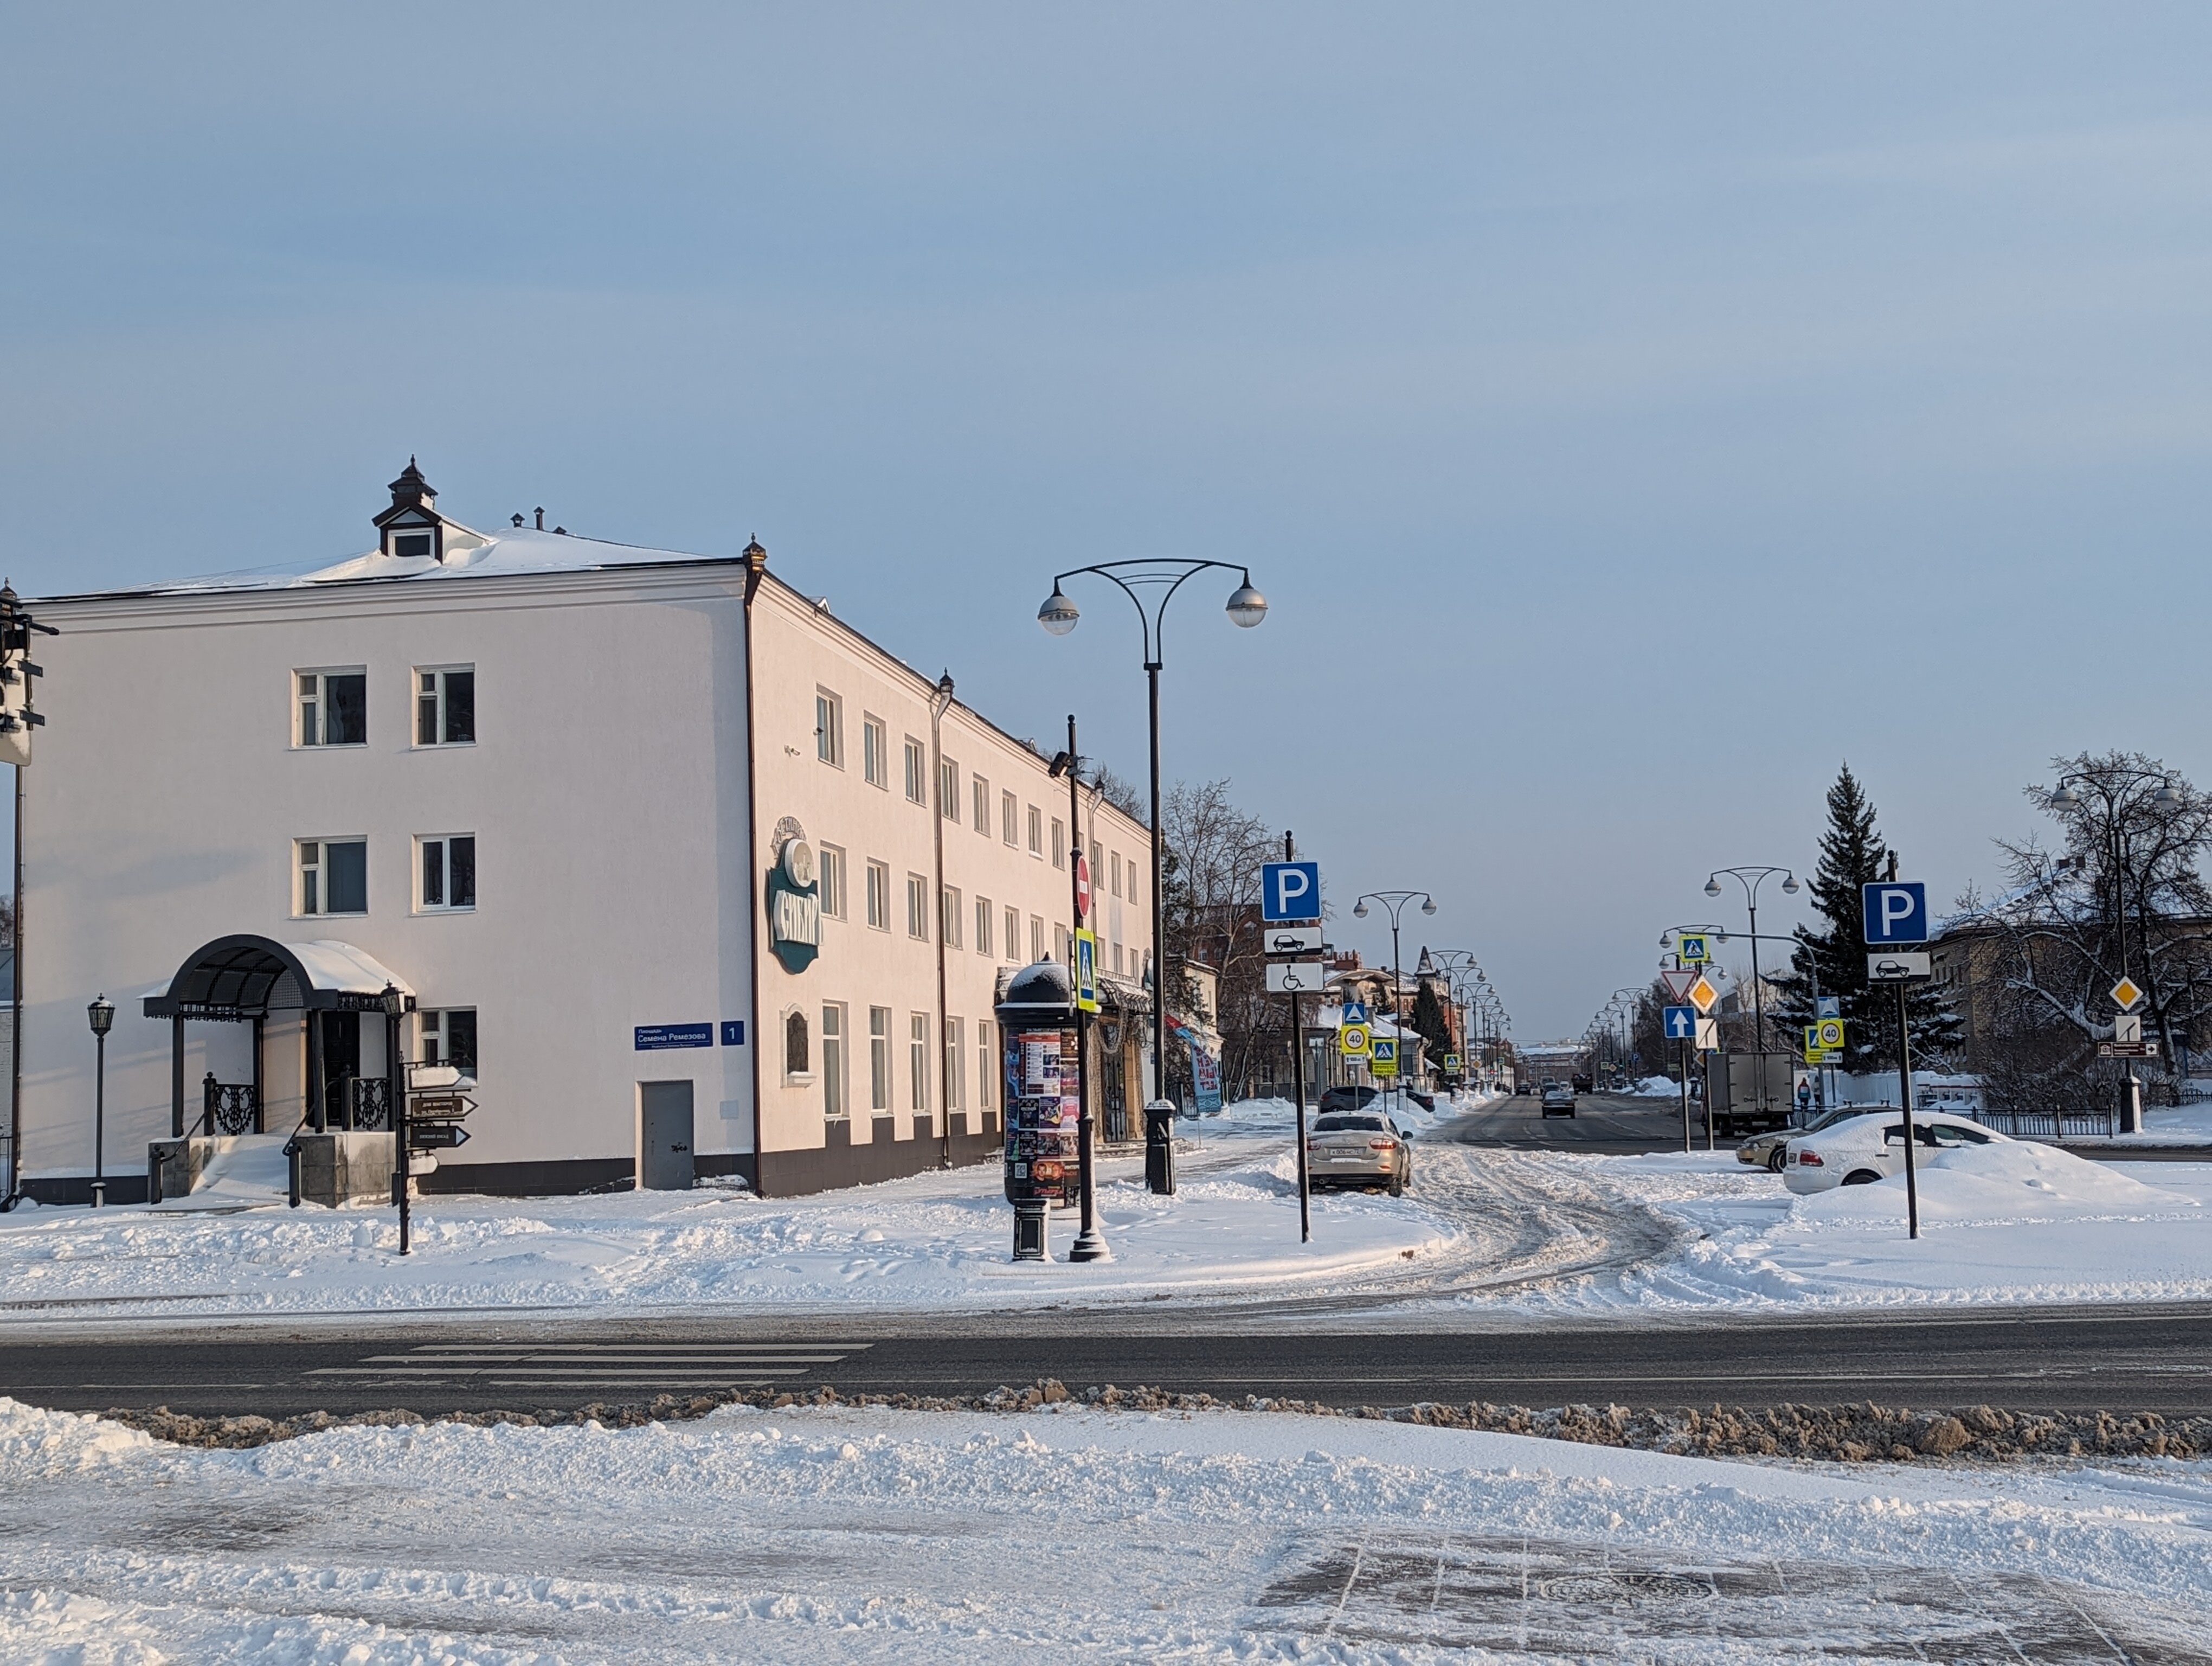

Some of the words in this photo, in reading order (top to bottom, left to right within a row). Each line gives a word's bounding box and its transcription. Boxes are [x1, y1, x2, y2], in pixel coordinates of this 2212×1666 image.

[1278, 869, 1309, 913] P
[1881, 889, 1914, 936] P
[729, 1027, 735, 1039] 1
[1349, 1035, 1361, 1043] 40
[1825, 1029, 1837, 1037] 40
